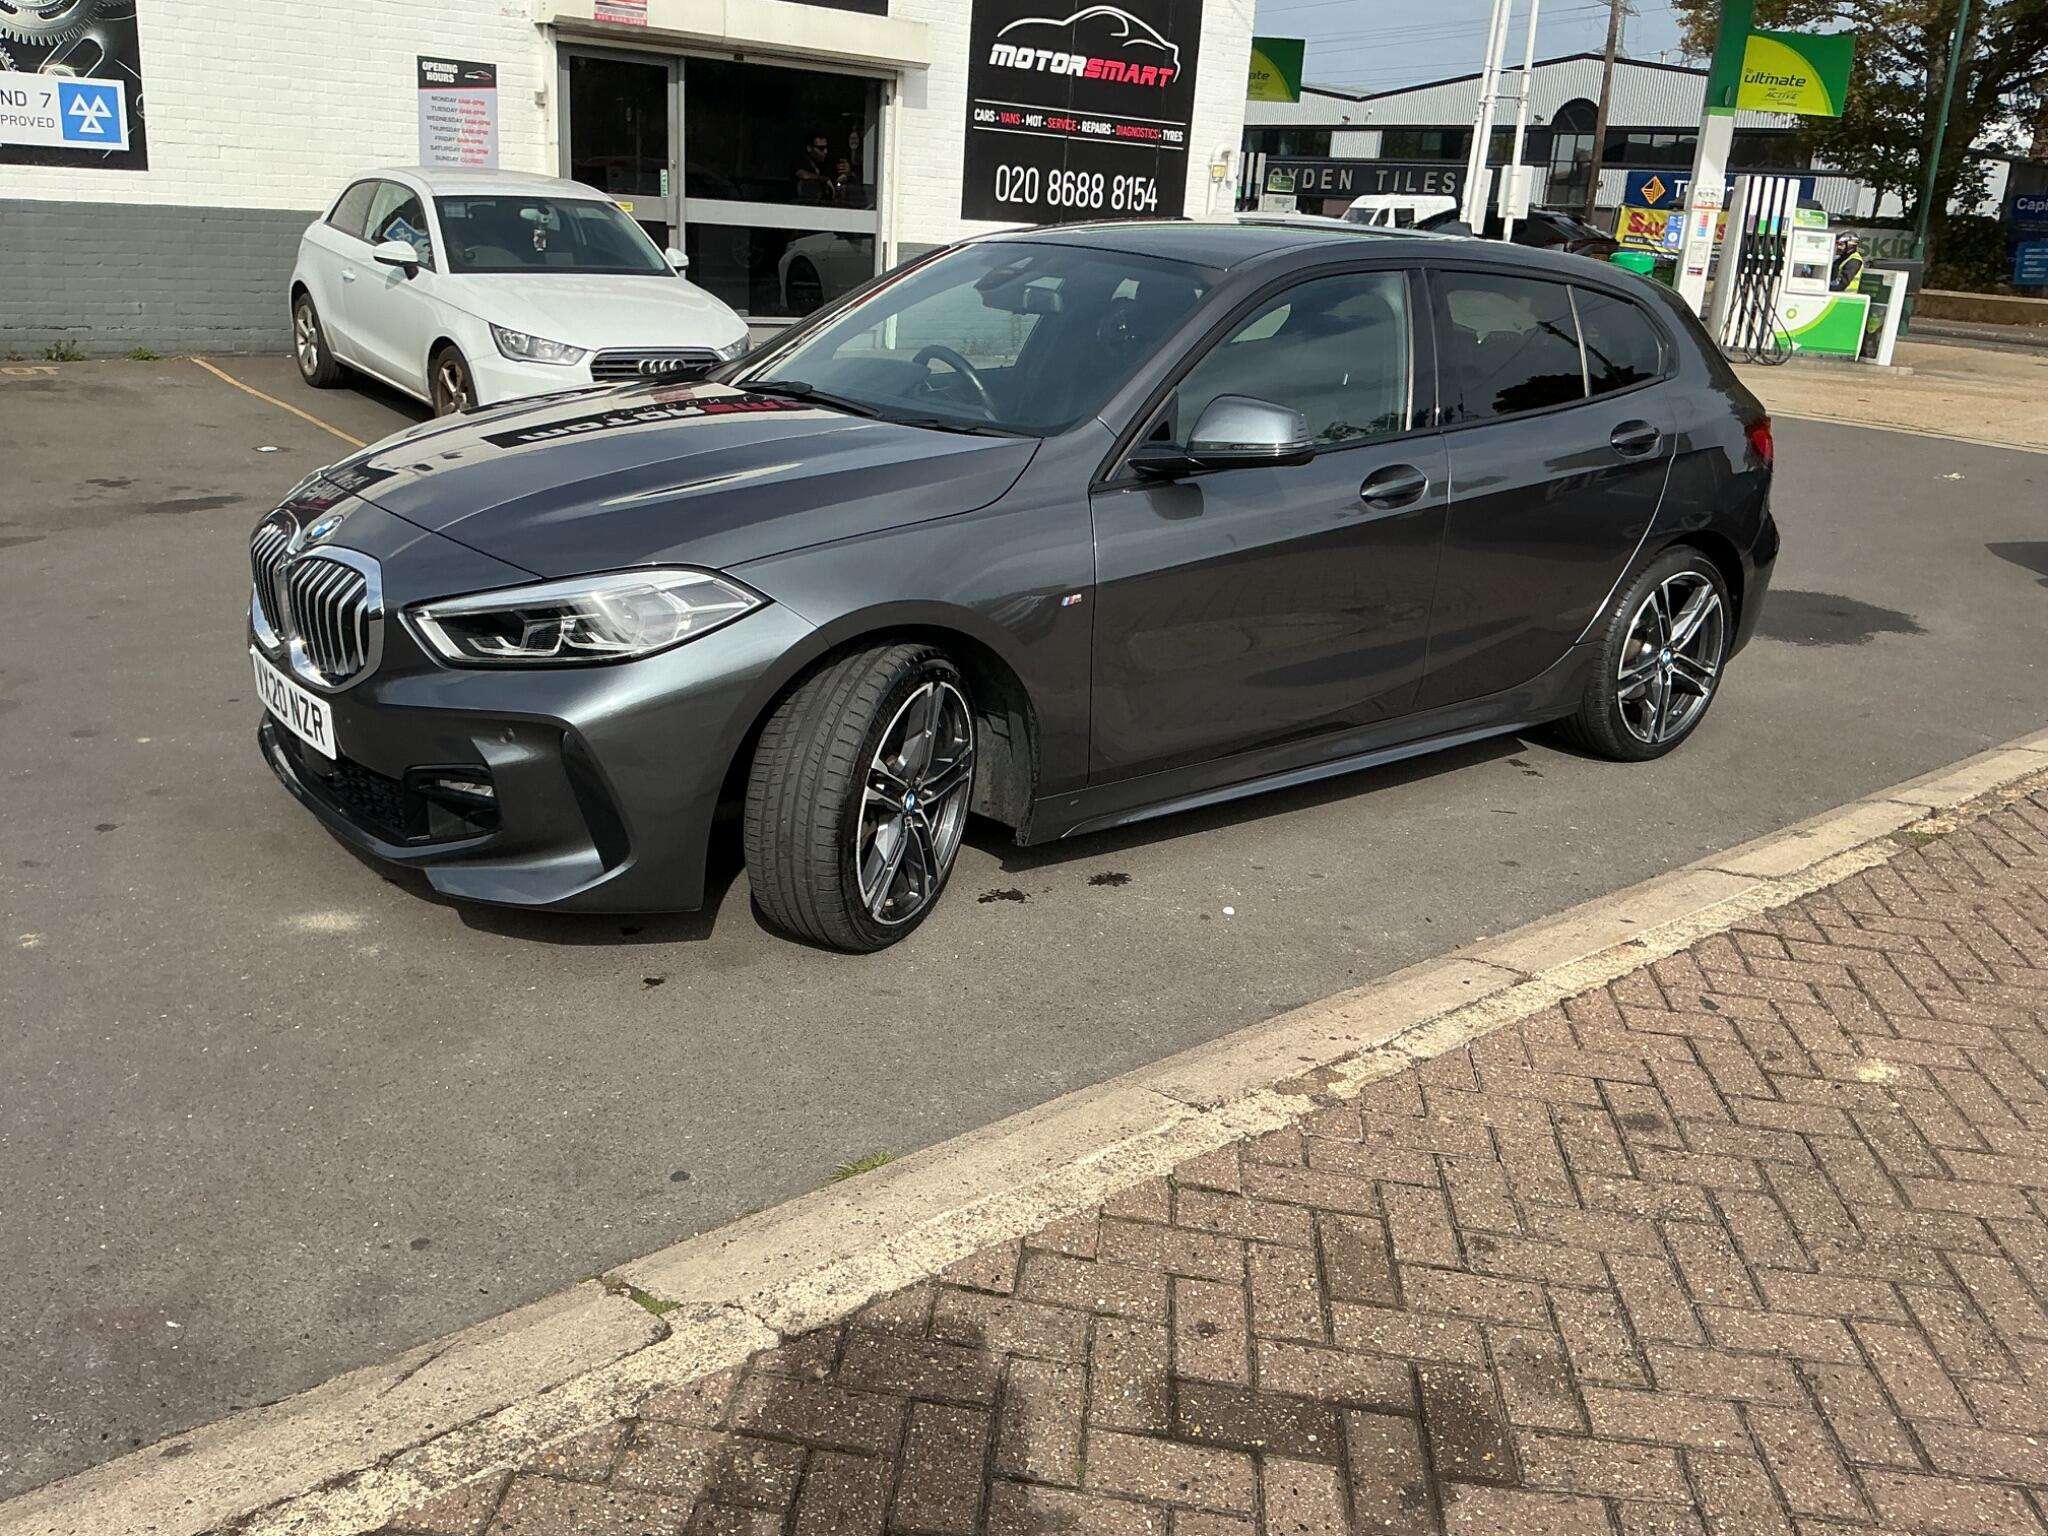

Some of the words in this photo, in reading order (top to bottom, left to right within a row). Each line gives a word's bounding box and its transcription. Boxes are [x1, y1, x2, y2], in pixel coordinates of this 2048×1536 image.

[422, 61, 458, 74] OPENING
[988, 43, 1174, 88] MOTORSMART
[426, 71, 455, 83] HOURS
[1744, 71, 1807, 87] ultimate
[39, 92, 52, 108] 7
[1766, 91, 1799, 100] ACTIVE
[431, 105, 458, 113] TUESDAY
[426, 115, 463, 123] WEDNESDAY
[974, 108, 995, 122] CARS
[1000, 111, 1020, 125] VANS
[1025, 115, 1043, 127] MOT
[1047, 117, 1077, 132] SERVICE
[1082, 121, 1111, 135] REPAIRS
[1116, 124, 1158, 139] DIAGNOSTICS
[1162, 129, 1183, 142] TYRES
[995, 165, 1039, 204] 020
[1047, 169, 1104, 208] 8688
[1111, 174, 1158, 212] 8154
[1376, 170, 1457, 194] TILES
[289, 687, 326, 746] NZR
